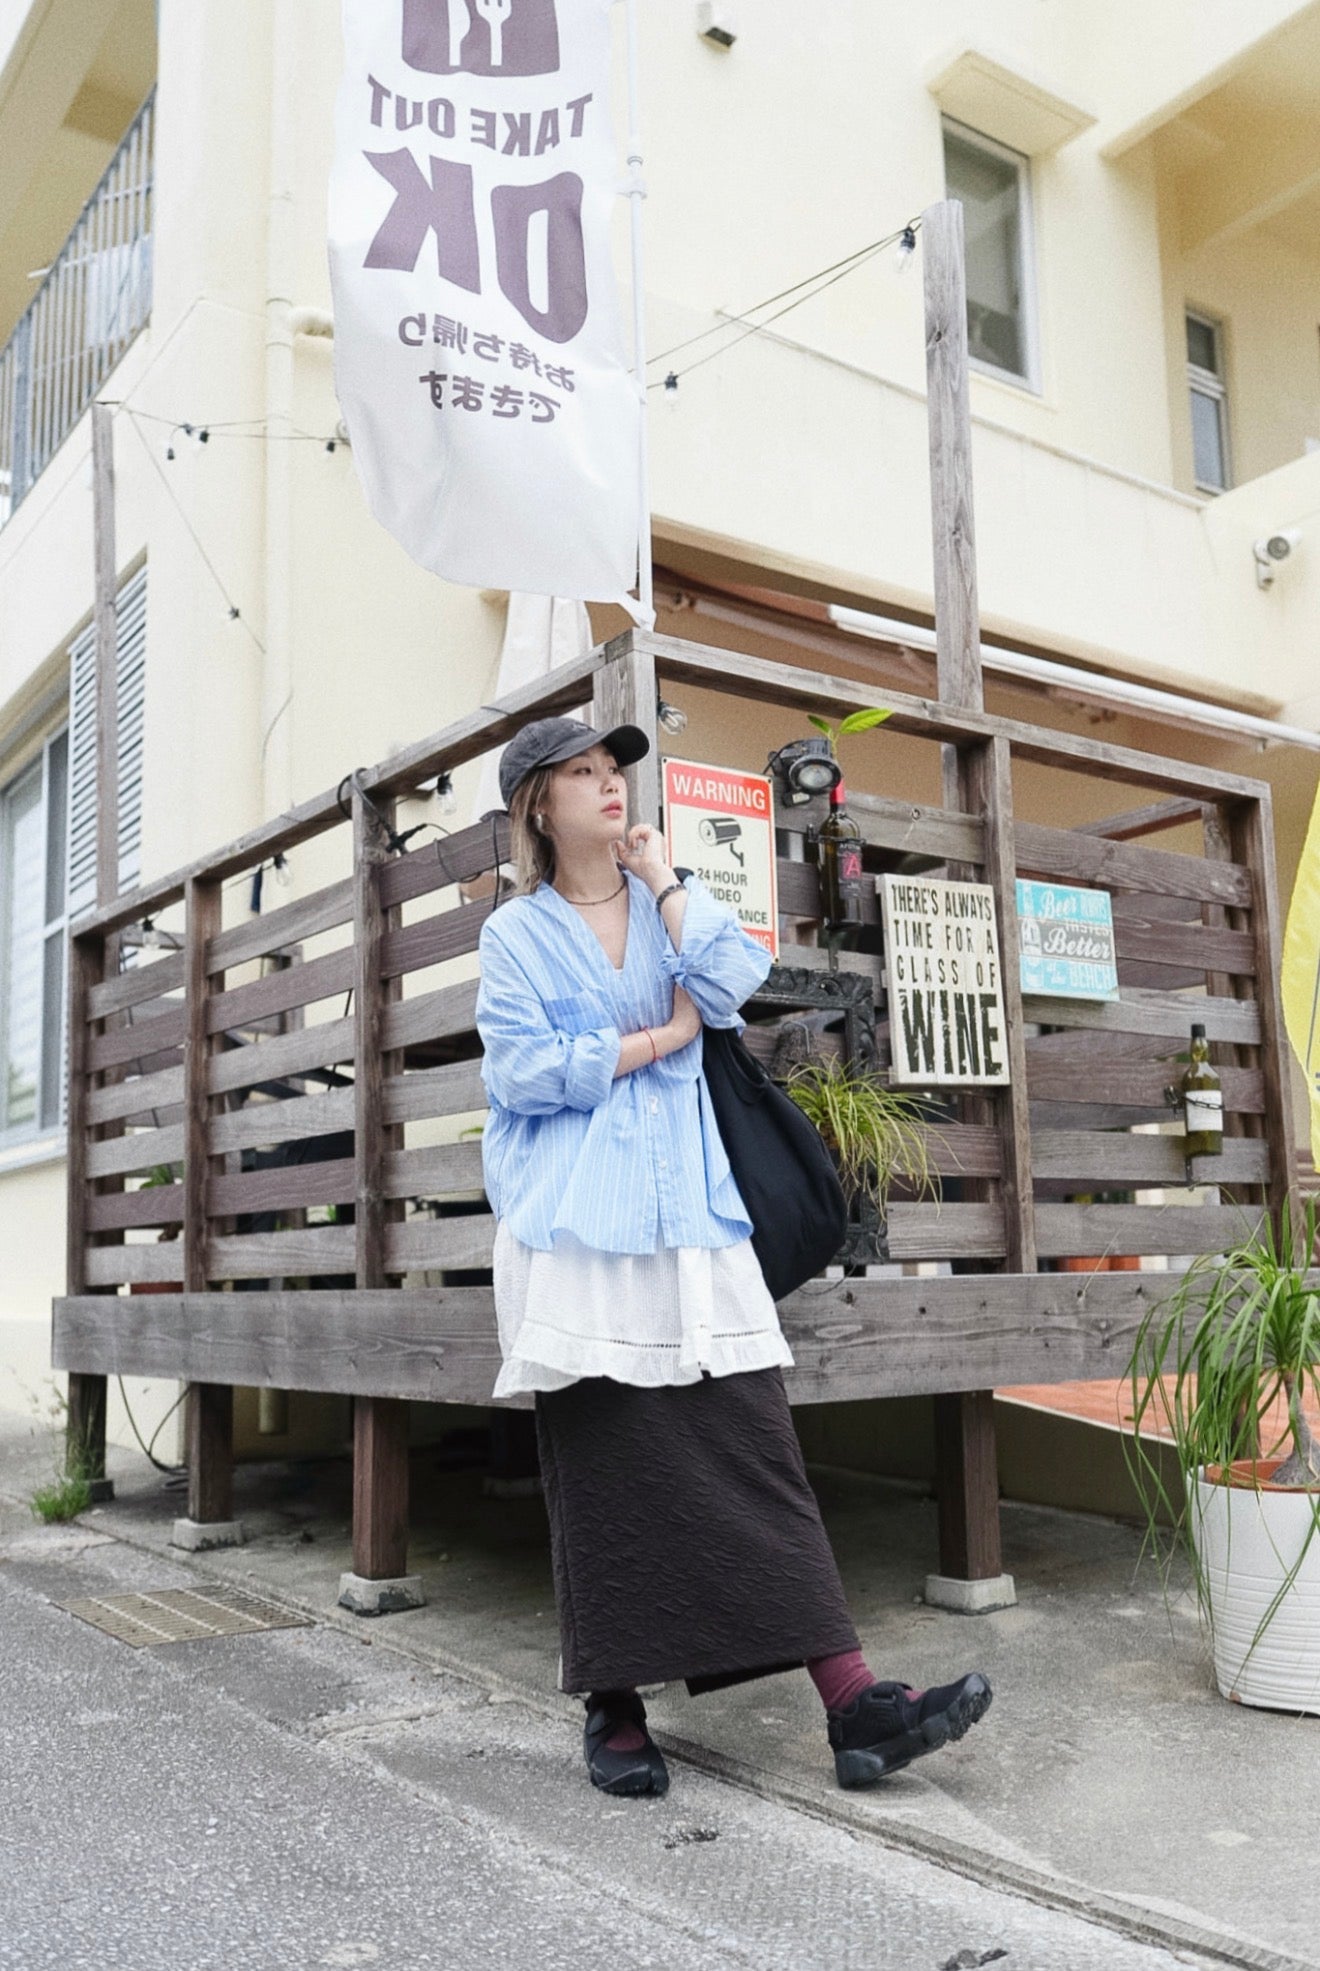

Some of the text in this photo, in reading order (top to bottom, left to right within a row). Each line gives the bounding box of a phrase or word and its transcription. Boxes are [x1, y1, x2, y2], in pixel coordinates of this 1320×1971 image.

[672, 773, 765, 810] WARNING
[697, 868, 748, 886] 24 HOUR
[892, 884, 992, 921] THERE'S ALWAYS
[894, 919, 994, 954] TIME FOR A
[1043, 927, 1110, 959] Better
[896, 955, 996, 988] GLASS OF
[899, 988, 1003, 1076] WINE
